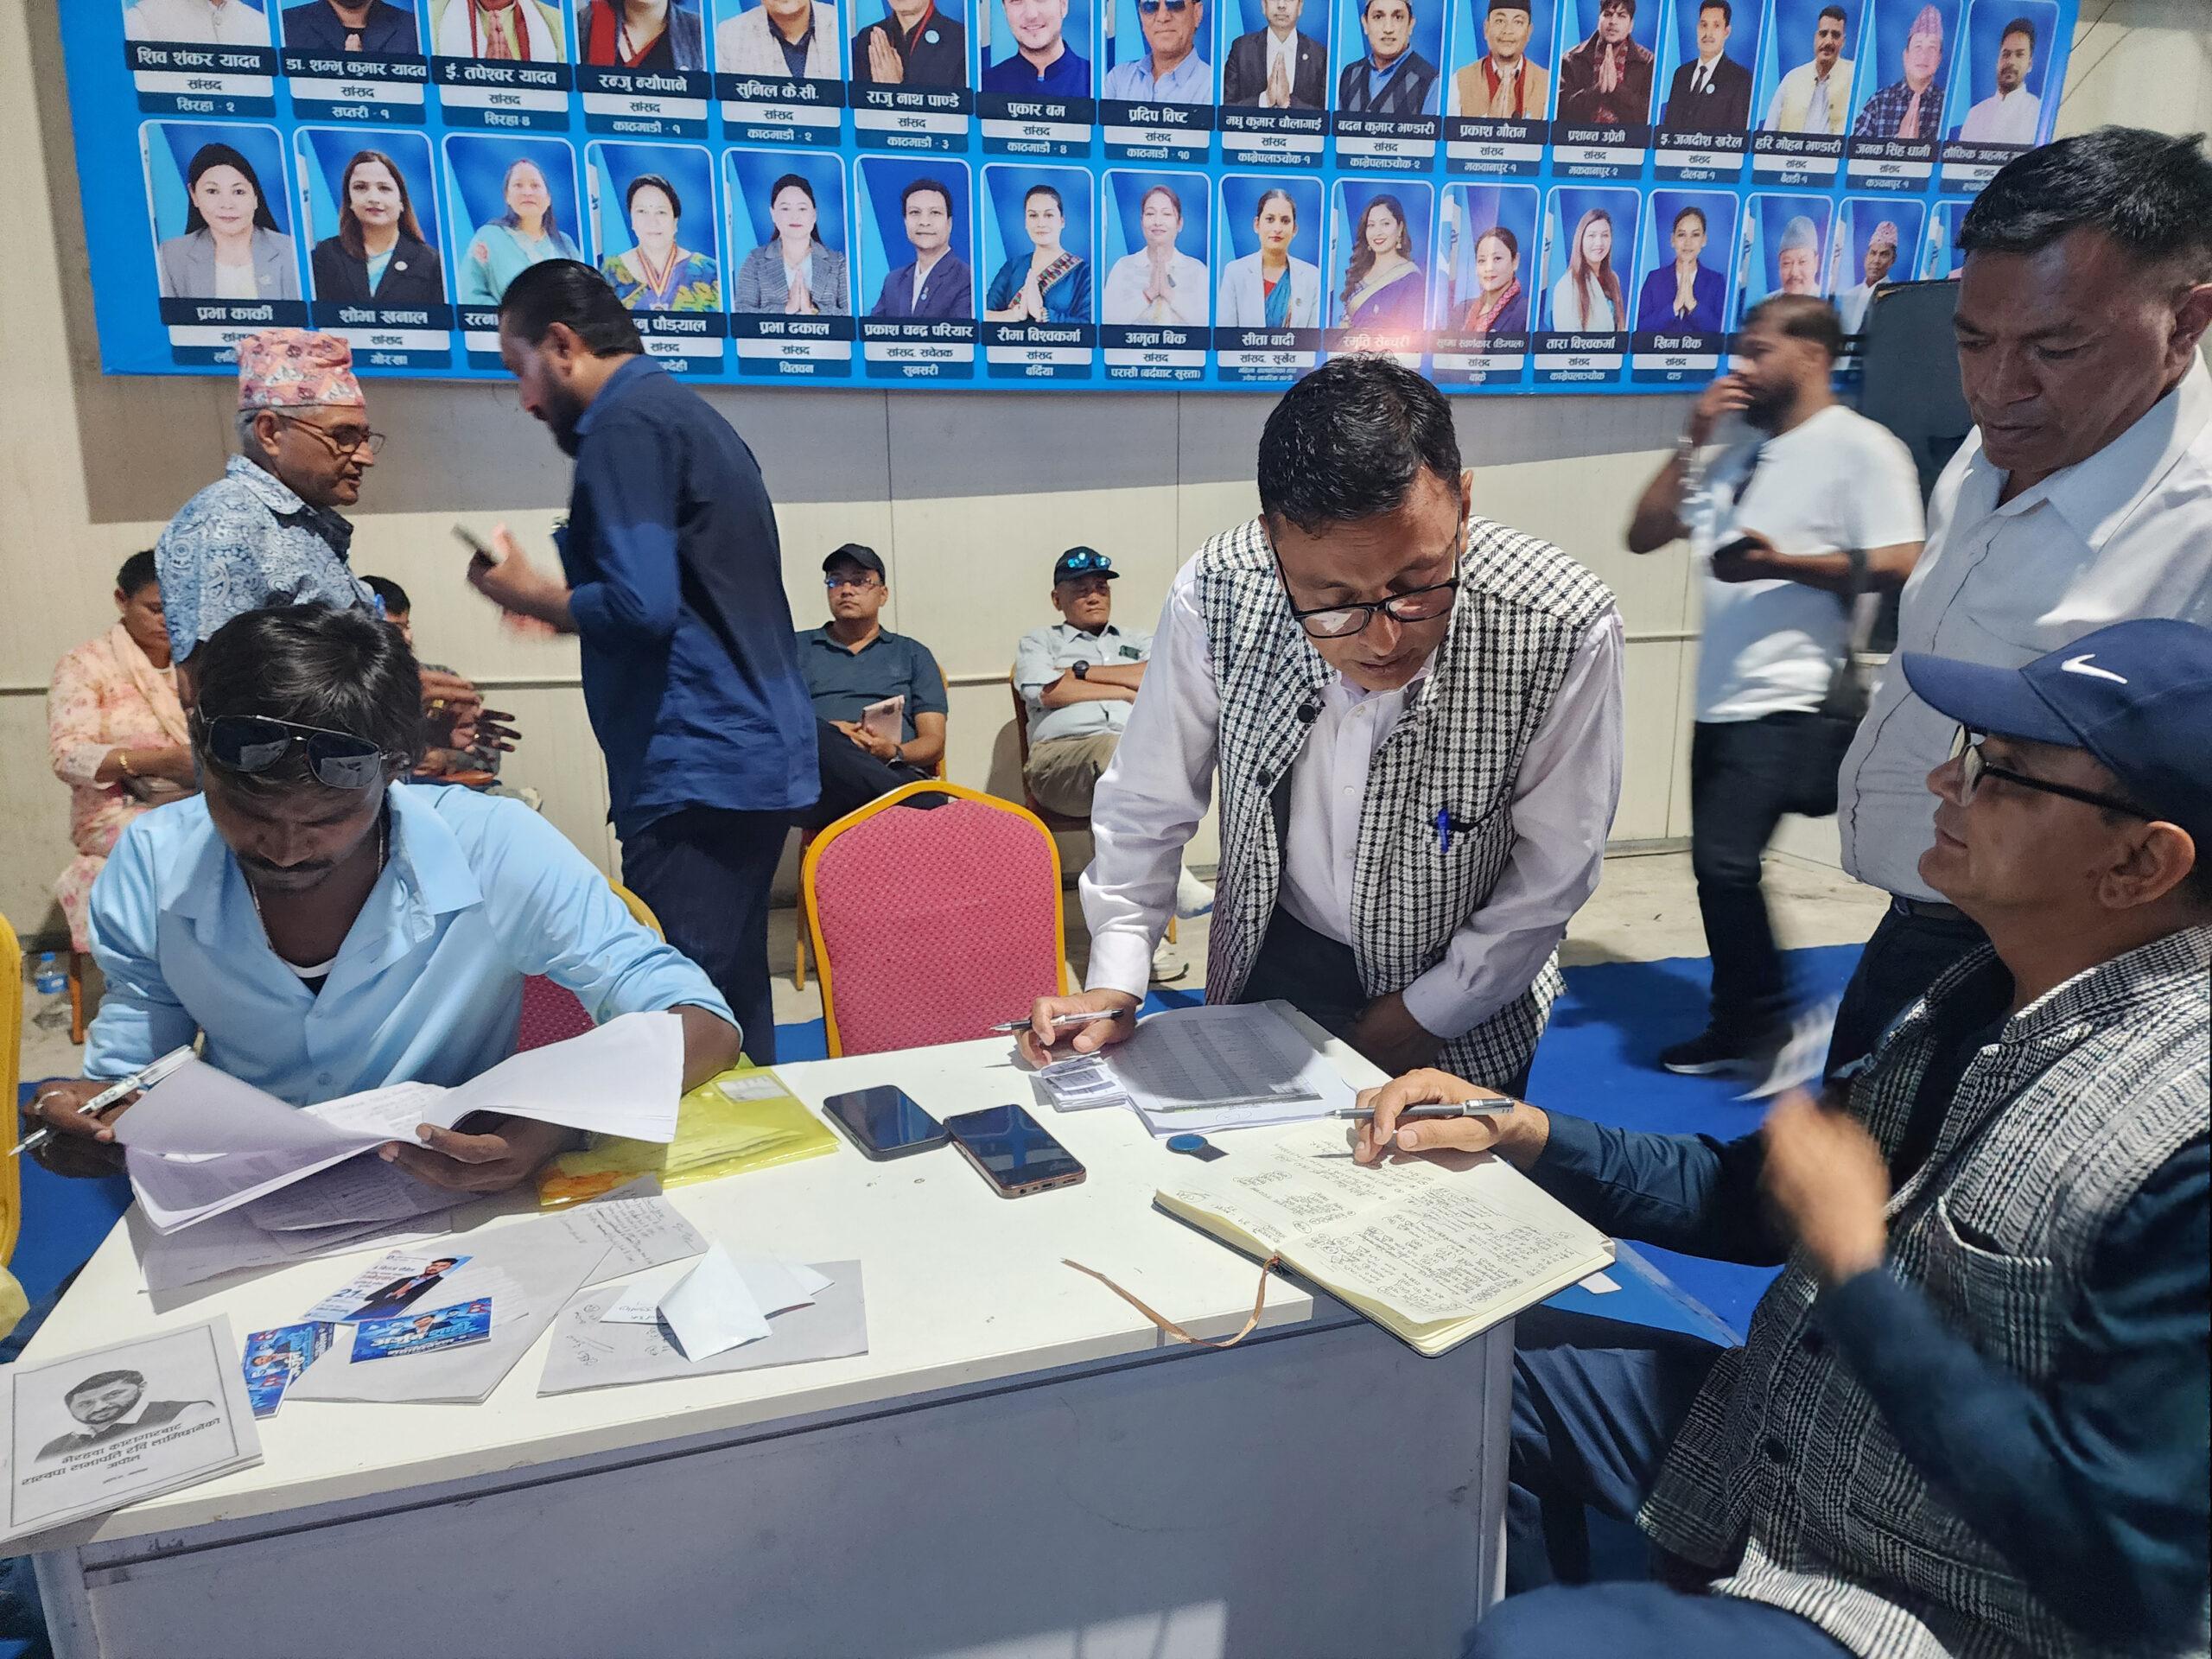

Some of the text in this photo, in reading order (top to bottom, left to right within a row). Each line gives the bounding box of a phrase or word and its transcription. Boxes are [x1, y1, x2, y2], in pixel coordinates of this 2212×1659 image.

[137, 46, 260, 68] शिव शंकर यादव
[346, 61, 388, 76] कुमार
[391, 64, 427, 77] यादव
[518, 70, 557, 85] यादव
[188, 78, 222, 90] सांसद
[340, 86, 375, 98] सांसद
[489, 93, 521, 105] सांसद
[867, 91, 960, 108] राजु नाथ पाण्डे
[629, 101, 661, 113] सांसद
[1007, 102, 1043, 118] पुकार
[764, 109, 794, 121] सांसद
[898, 117, 927, 128] सांसद
[1246, 117, 1276, 129] कुमार
[1364, 122, 1395, 135] कुमार
[1397, 121, 1435, 135] भण्डारी
[1023, 125, 1051, 136] सांसद
[1145, 131, 1173, 142] सांसद
[1459, 123, 1527, 138] प्रकाश गौतम
[1262, 137, 1287, 147] सांसद
[1374, 142, 1398, 152] सांसद
[1755, 135, 1773, 149] हरि
[1480, 146, 1504, 156] सांसद
[760, 321, 830, 335] प्रभा ढकाल
[864, 322, 974, 338] प्रकाश चन्द्र परियार
[997, 327, 1025, 341] रीमा
[1125, 332, 1160, 346] अमृता
[1242, 332, 1268, 346] सीता
[1547, 339, 1569, 349] तारा
[781, 345, 810, 355] सांसद
[1027, 350, 1052, 359] सांसद
[1143, 353, 1169, 362] सांसद
[1568, 358, 1591, 366] सांसद
